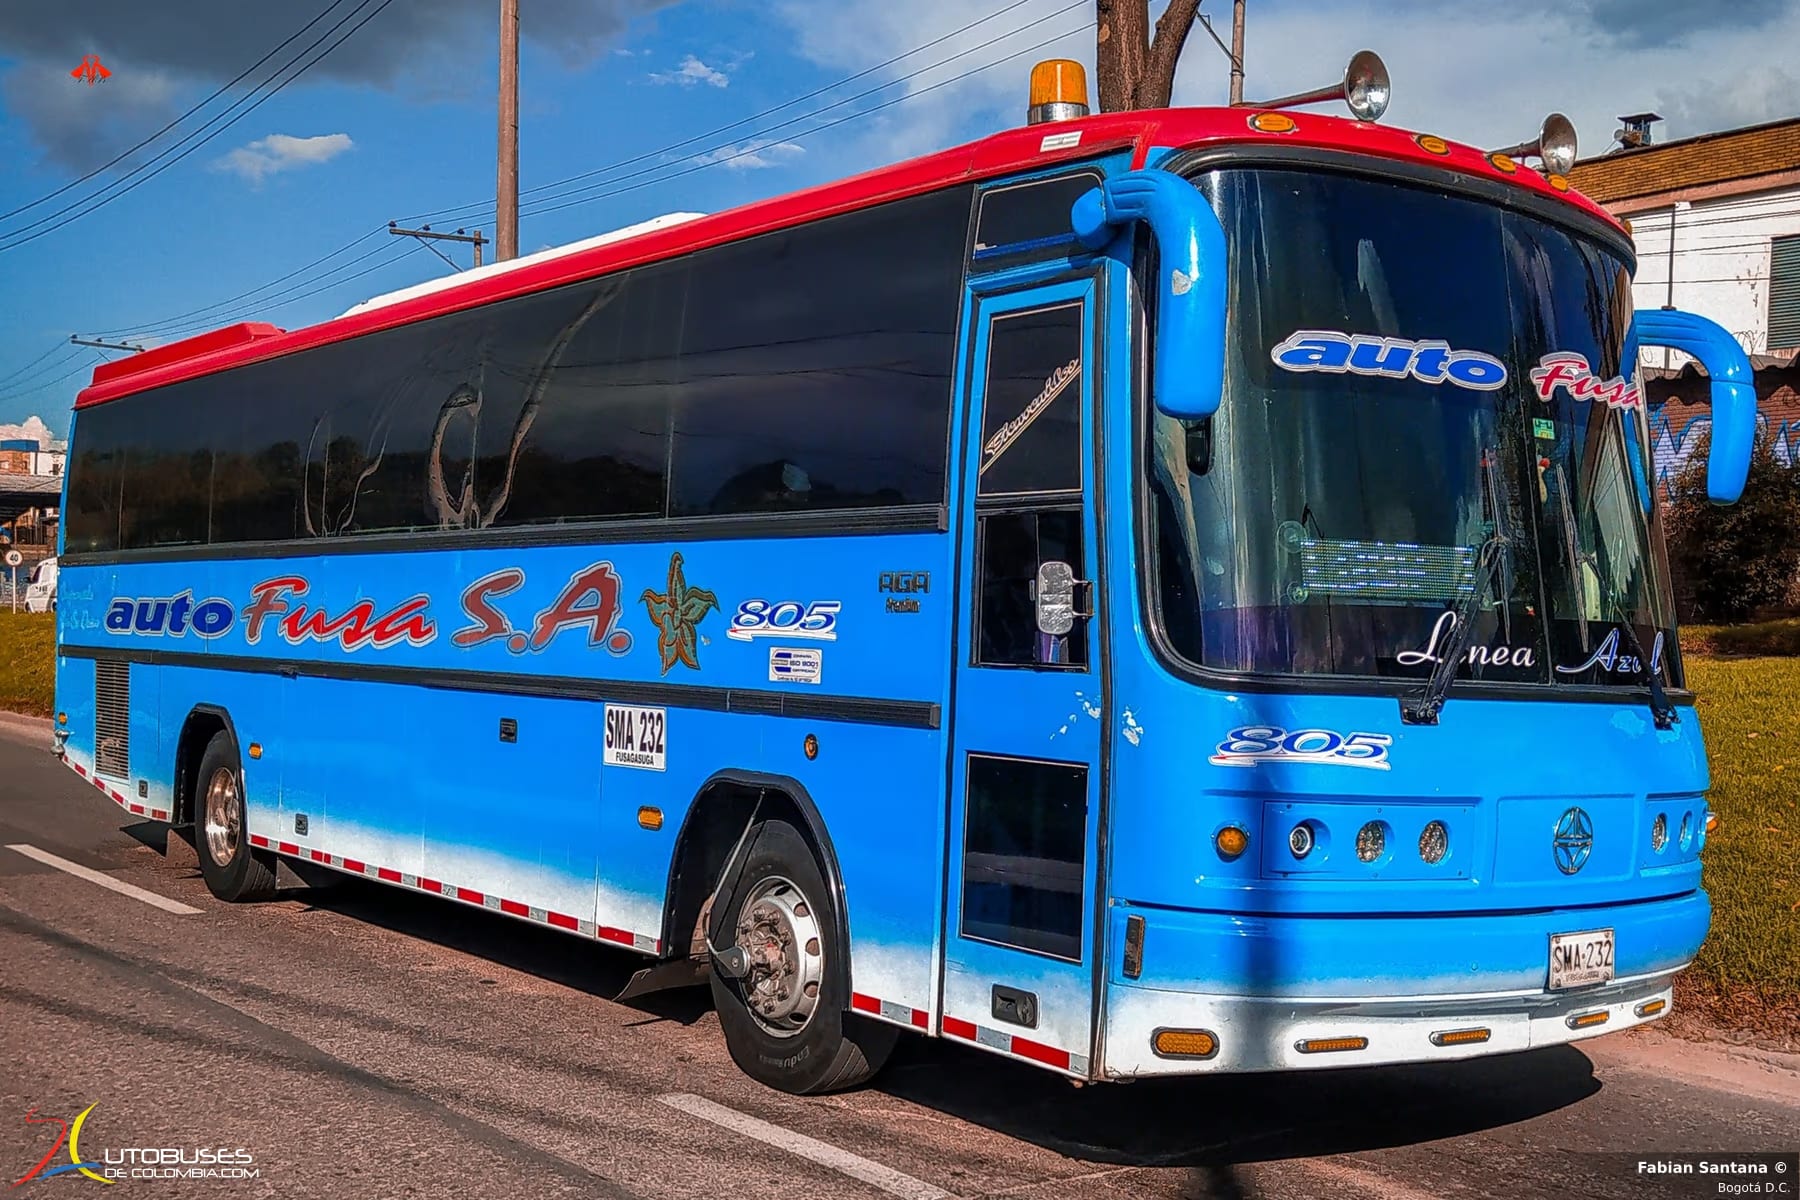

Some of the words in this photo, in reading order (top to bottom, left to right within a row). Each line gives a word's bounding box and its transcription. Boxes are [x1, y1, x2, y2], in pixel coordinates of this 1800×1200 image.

[1273, 332, 1506, 389] auto
[1531, 352, 1641, 411] Fusa
[10, 553, 19, 562] 40
[879, 571, 931, 594] AGA
[105, 589, 235, 636] auto
[241, 575, 437, 652] Fusa
[452, 561, 631, 655] S.A.
[730, 600, 842, 636] 805
[1397, 610, 1535, 668] Lnea
[606, 709, 634, 751] SMA
[640, 711, 664, 754] 232
[1212, 726, 1392, 764] 805
[615, 751, 655, 766] FUSAGASUGA
